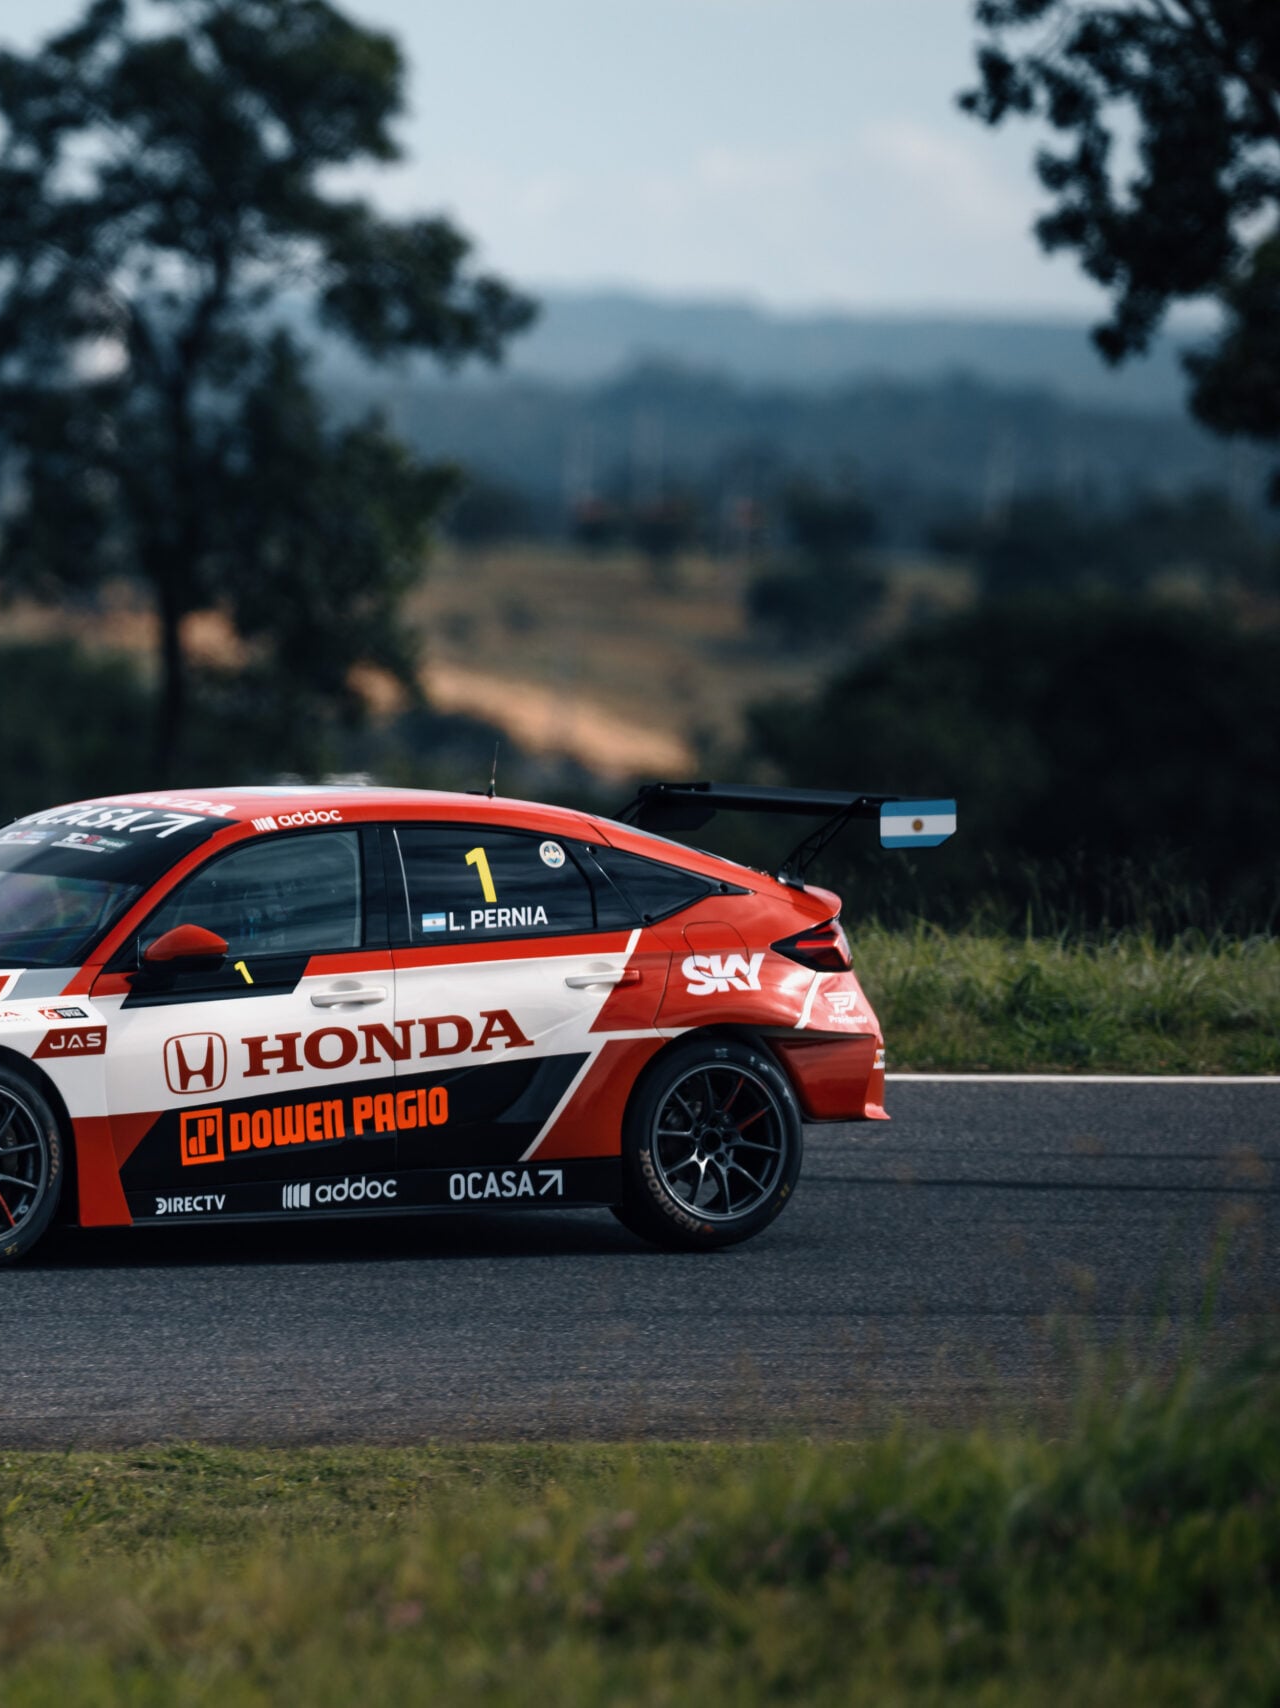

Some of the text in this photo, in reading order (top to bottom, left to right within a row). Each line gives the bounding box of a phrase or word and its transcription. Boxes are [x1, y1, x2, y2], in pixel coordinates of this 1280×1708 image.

[18, 804, 154, 831] OCASA
[278, 809, 343, 828] addoc
[465, 847, 497, 903] 1
[449, 905, 549, 931] L. PERNIA
[234, 961, 254, 985] 1
[681, 952, 766, 997] SKY
[49, 1032, 102, 1050] JAS
[240, 1008, 535, 1078] HONDA
[229, 1086, 449, 1153] DOWEN PAGIO
[315, 1176, 397, 1203] addoc
[449, 1170, 535, 1201] OCASA
[155, 1194, 226, 1215] DIRECTV
